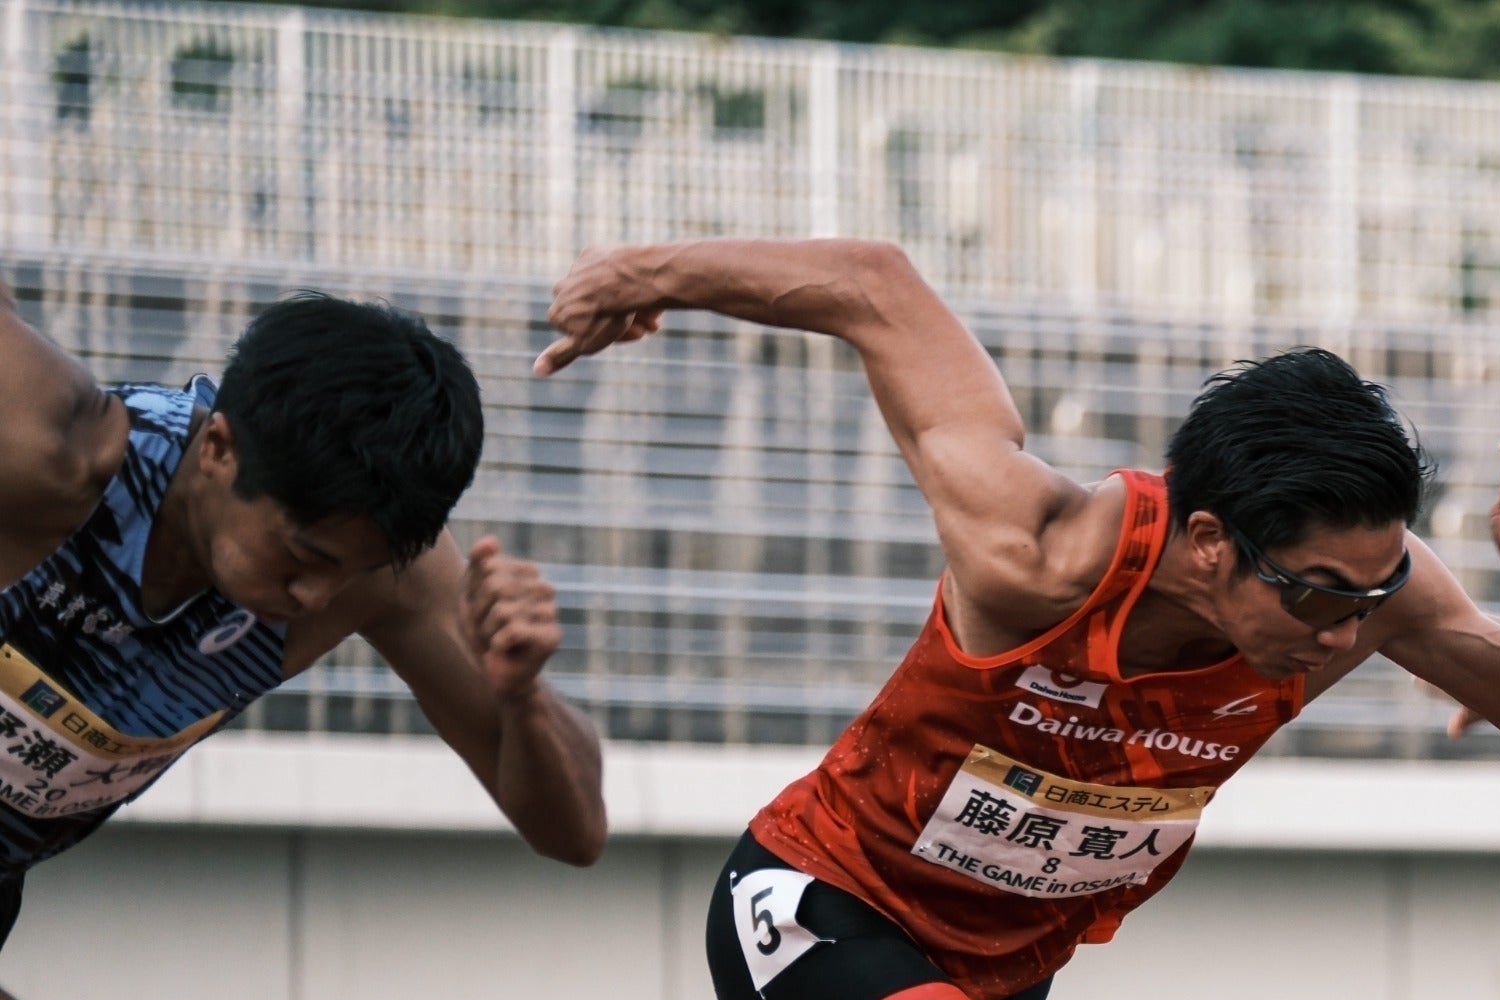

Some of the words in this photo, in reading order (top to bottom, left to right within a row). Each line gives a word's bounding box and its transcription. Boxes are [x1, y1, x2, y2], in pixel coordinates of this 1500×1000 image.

[1029, 681, 1059, 698] Daiwa
[1008, 701, 1125, 744] Daiwa
[1127, 728, 1240, 761] House
[24, 777, 67, 801] 20
[1044, 784, 1170, 813] 日商エステム
[937, 843, 982, 874] THE
[982, 863, 1043, 893] GAME
[1046, 877, 1068, 894] in
[1069, 871, 1137, 894] OSAKA
[1041, 856, 1061, 874] 8
[750, 886, 781, 956] 5
